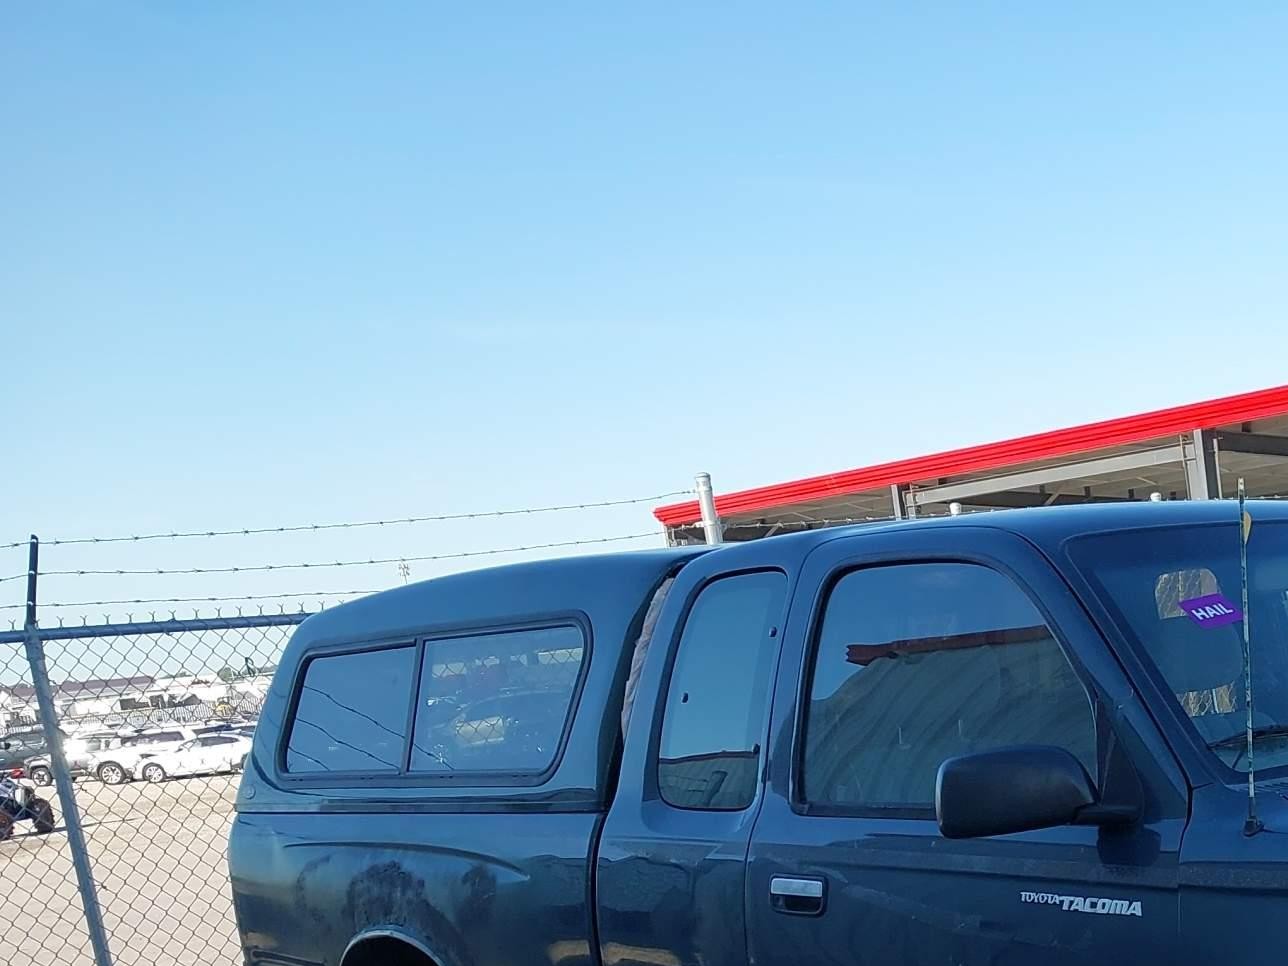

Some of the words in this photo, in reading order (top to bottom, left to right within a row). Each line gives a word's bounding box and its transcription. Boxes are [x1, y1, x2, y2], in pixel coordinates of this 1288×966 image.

[1191, 603, 1234, 620] HAIL
[1020, 891, 1060, 905] TOYOTA
[1058, 895, 1143, 917] TACOMA
